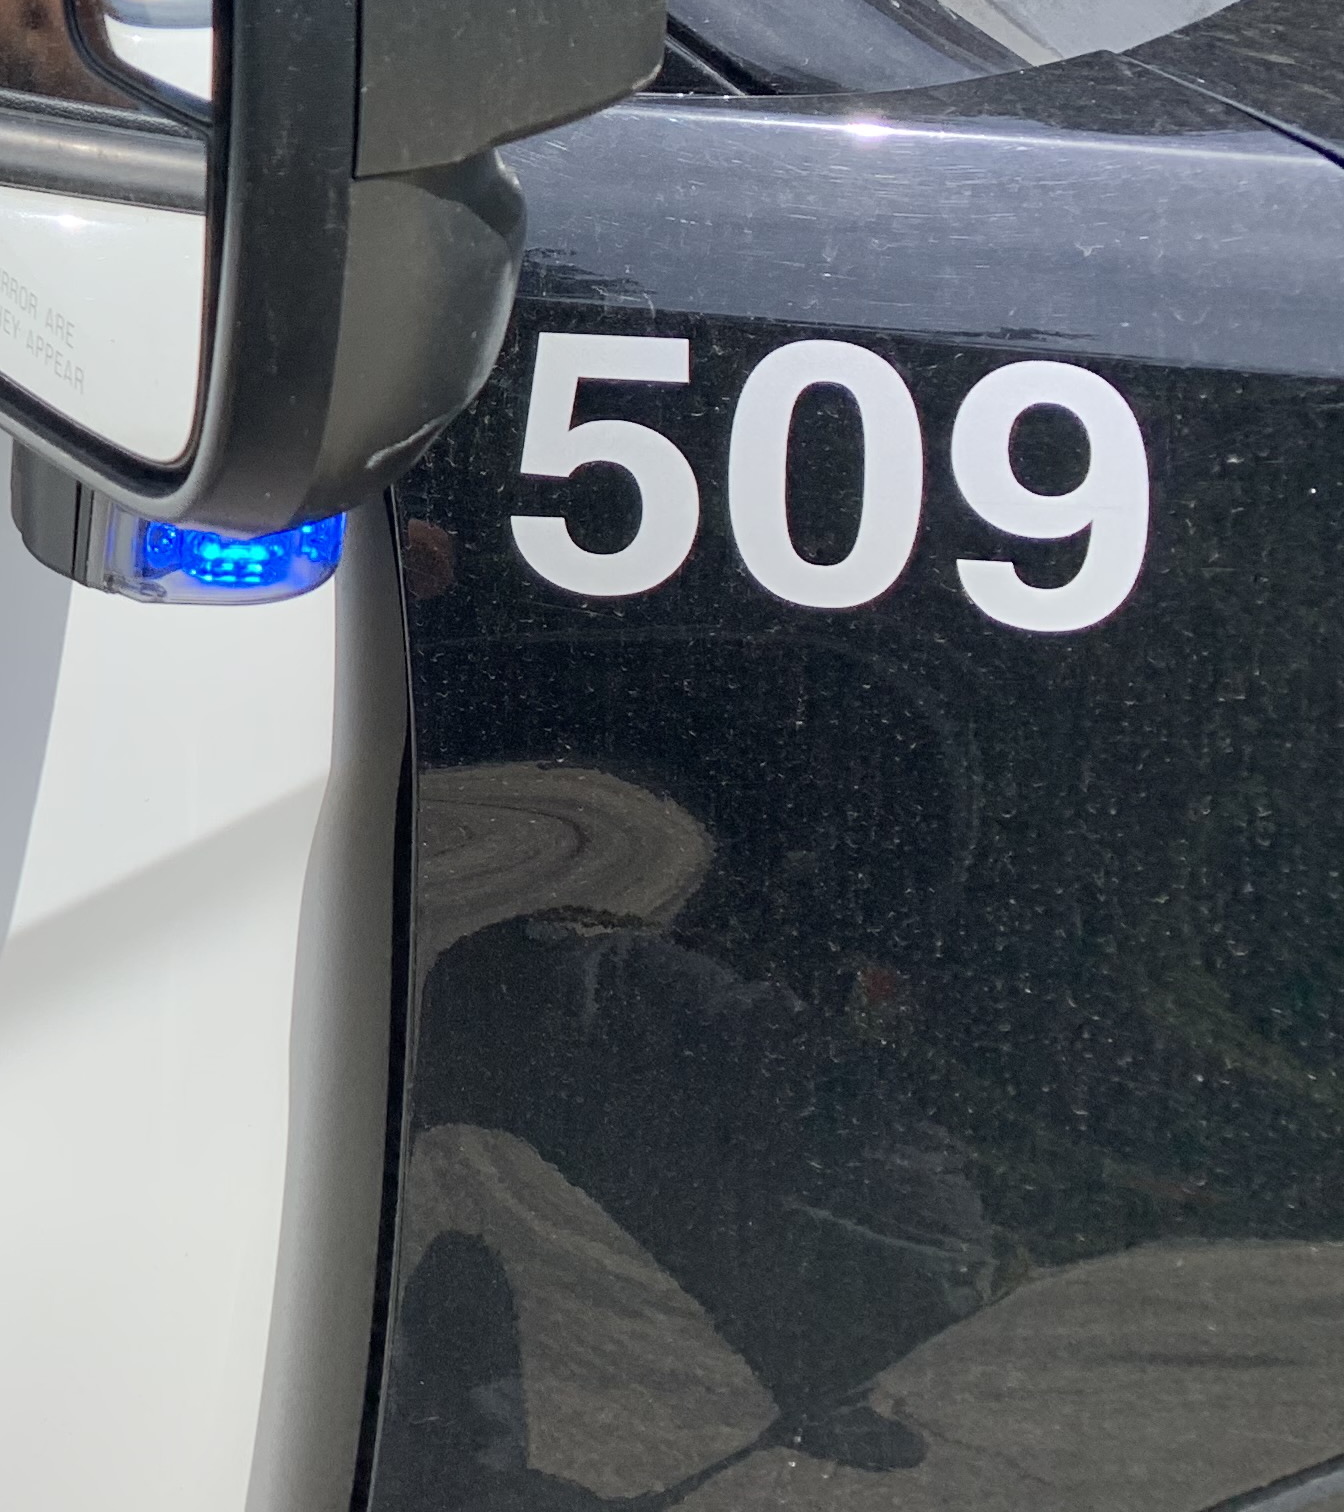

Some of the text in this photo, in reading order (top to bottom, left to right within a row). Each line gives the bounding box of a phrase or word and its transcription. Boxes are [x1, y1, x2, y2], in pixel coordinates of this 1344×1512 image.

[44, 307, 76, 349] ARE
[25, 330, 86, 395] APPEAR
[510, 331, 1151, 632] 509
